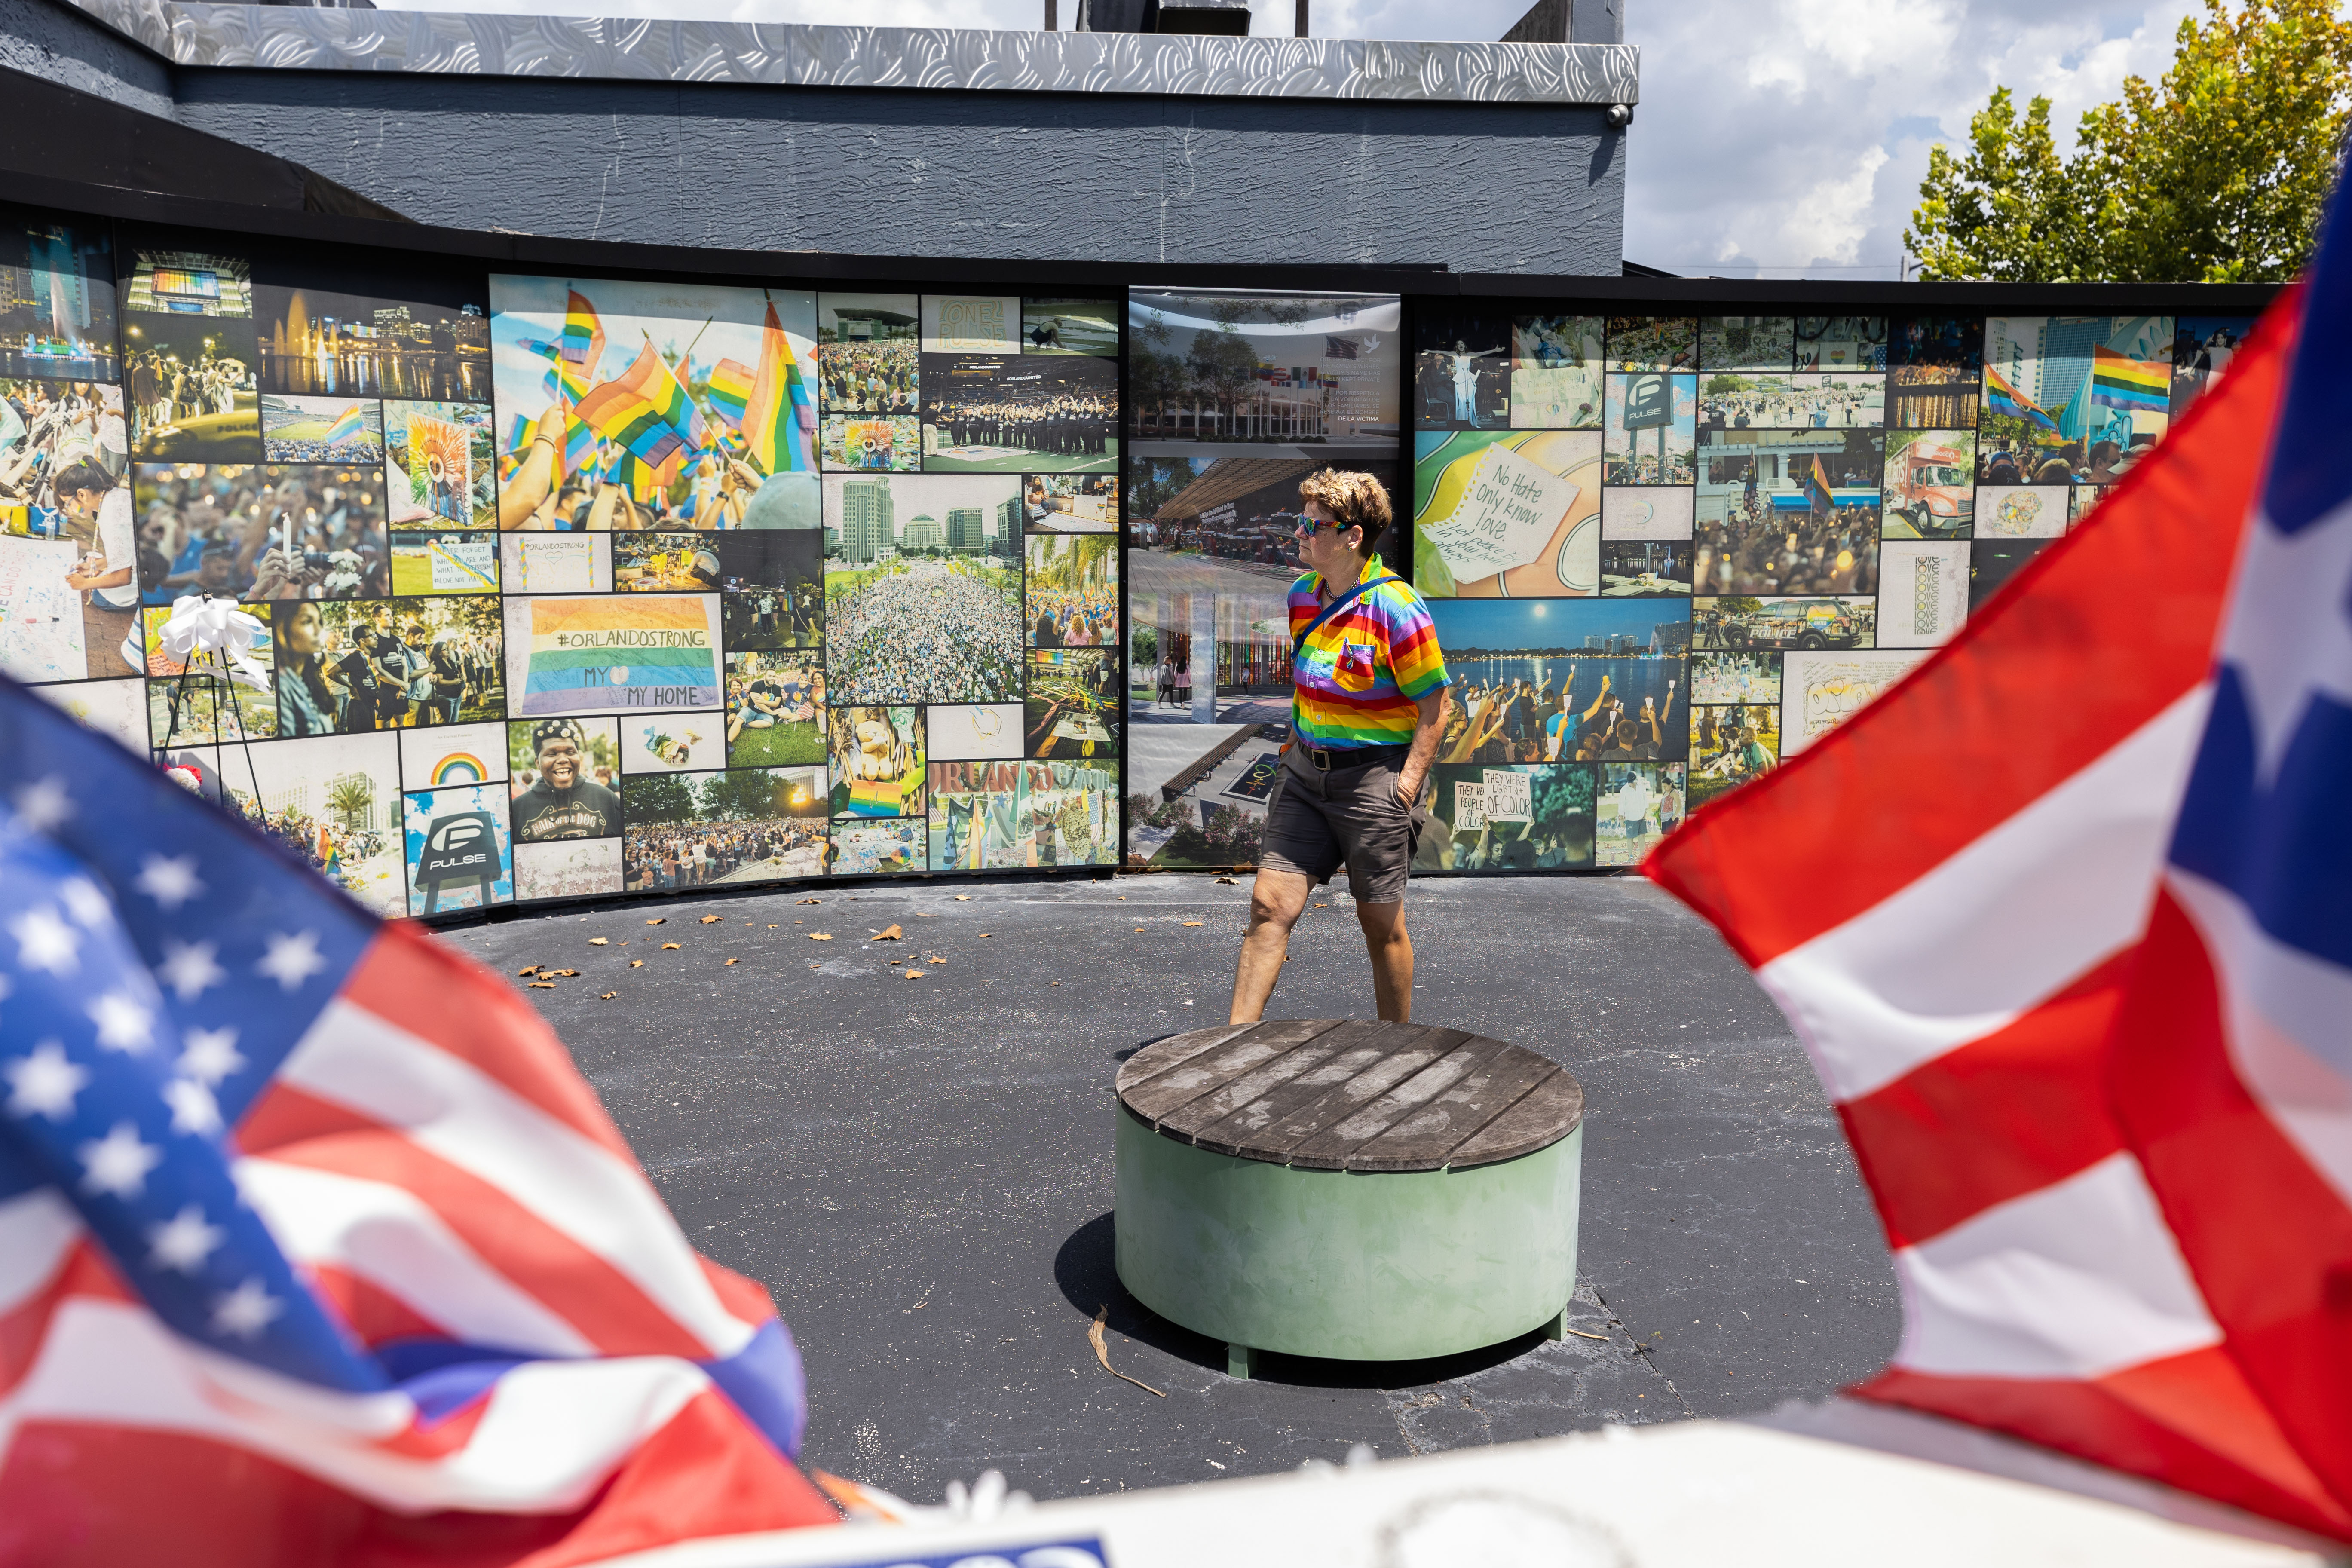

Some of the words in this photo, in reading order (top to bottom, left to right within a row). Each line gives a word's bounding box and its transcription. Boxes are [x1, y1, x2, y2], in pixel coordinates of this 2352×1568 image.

[948, 305, 992, 324] ONE
[940, 323, 1005, 346] PULSE
[1629, 407, 1661, 420] PULSE
[1492, 464, 1510, 486] No
[1510, 473, 1543, 503] Hate
[1476, 484, 1505, 514] Only
[1503, 498, 1543, 525] know
[525, 542, 585, 551] #ORLANDOSTRONG
[1435, 529, 1452, 538] in
[1447, 540, 1480, 553] your
[1449, 524, 1475, 537] Let
[1465, 537, 1505, 554] peace
[436, 547, 459, 555] NEVER
[557, 630, 705, 647] #ORLANDOSTRONG
[1750, 629, 1797, 639] POLICE
[585, 667, 609, 687] MY
[628, 686, 648, 705] MY
[655, 686, 701, 705] HOME
[1485, 773, 1504, 784] THEY
[1505, 775, 1526, 787] WERE
[1458, 785, 1474, 796] THEY
[1461, 797, 1484, 811] PEOPLE
[1488, 795, 1501, 814] OF
[1501, 795, 1531, 818] COLOR
[531, 817, 555, 836] HAIR
[555, 817, 563, 825] OF
[577, 813, 597, 827] DOG
[1459, 816, 1485, 828] COLOR
[430, 854, 487, 870] PULSE
